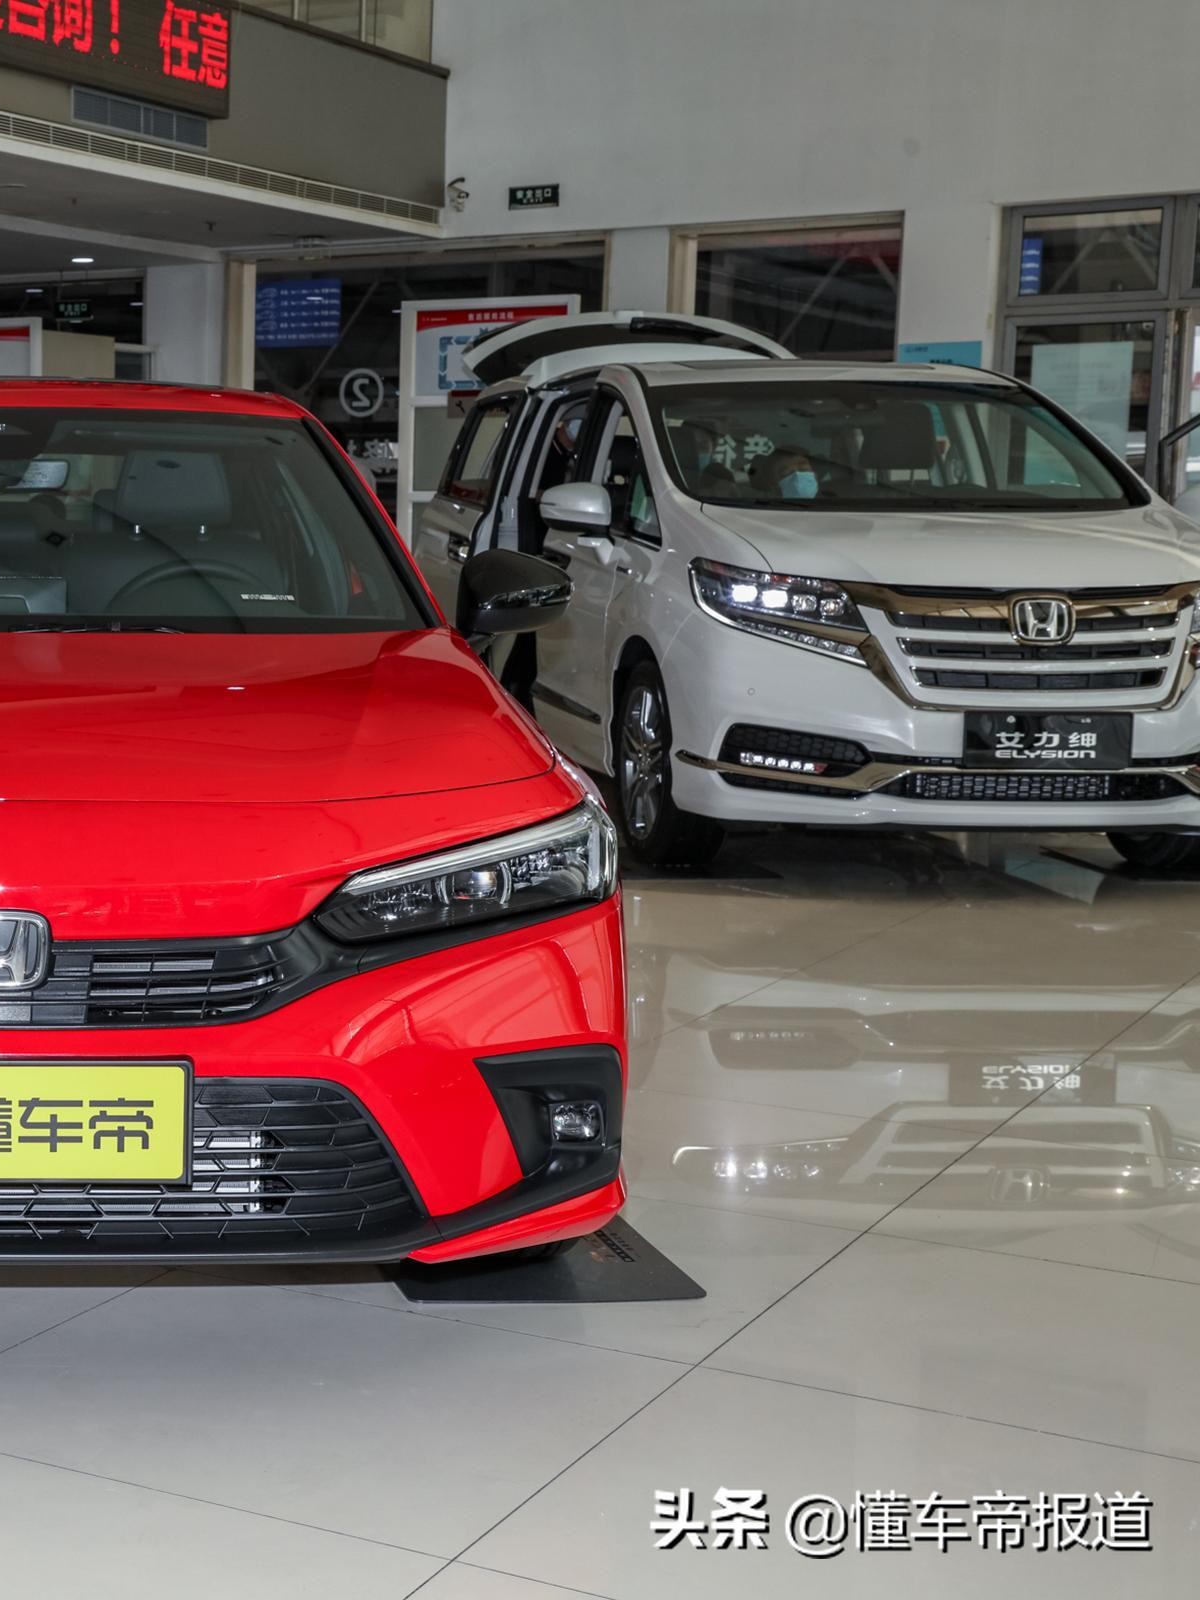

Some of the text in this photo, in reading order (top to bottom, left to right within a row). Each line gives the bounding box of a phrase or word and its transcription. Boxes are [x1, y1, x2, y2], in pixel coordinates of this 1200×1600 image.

[995, 731, 1098, 749] 艾力绅
[994, 749, 1097, 759] ELYSION
